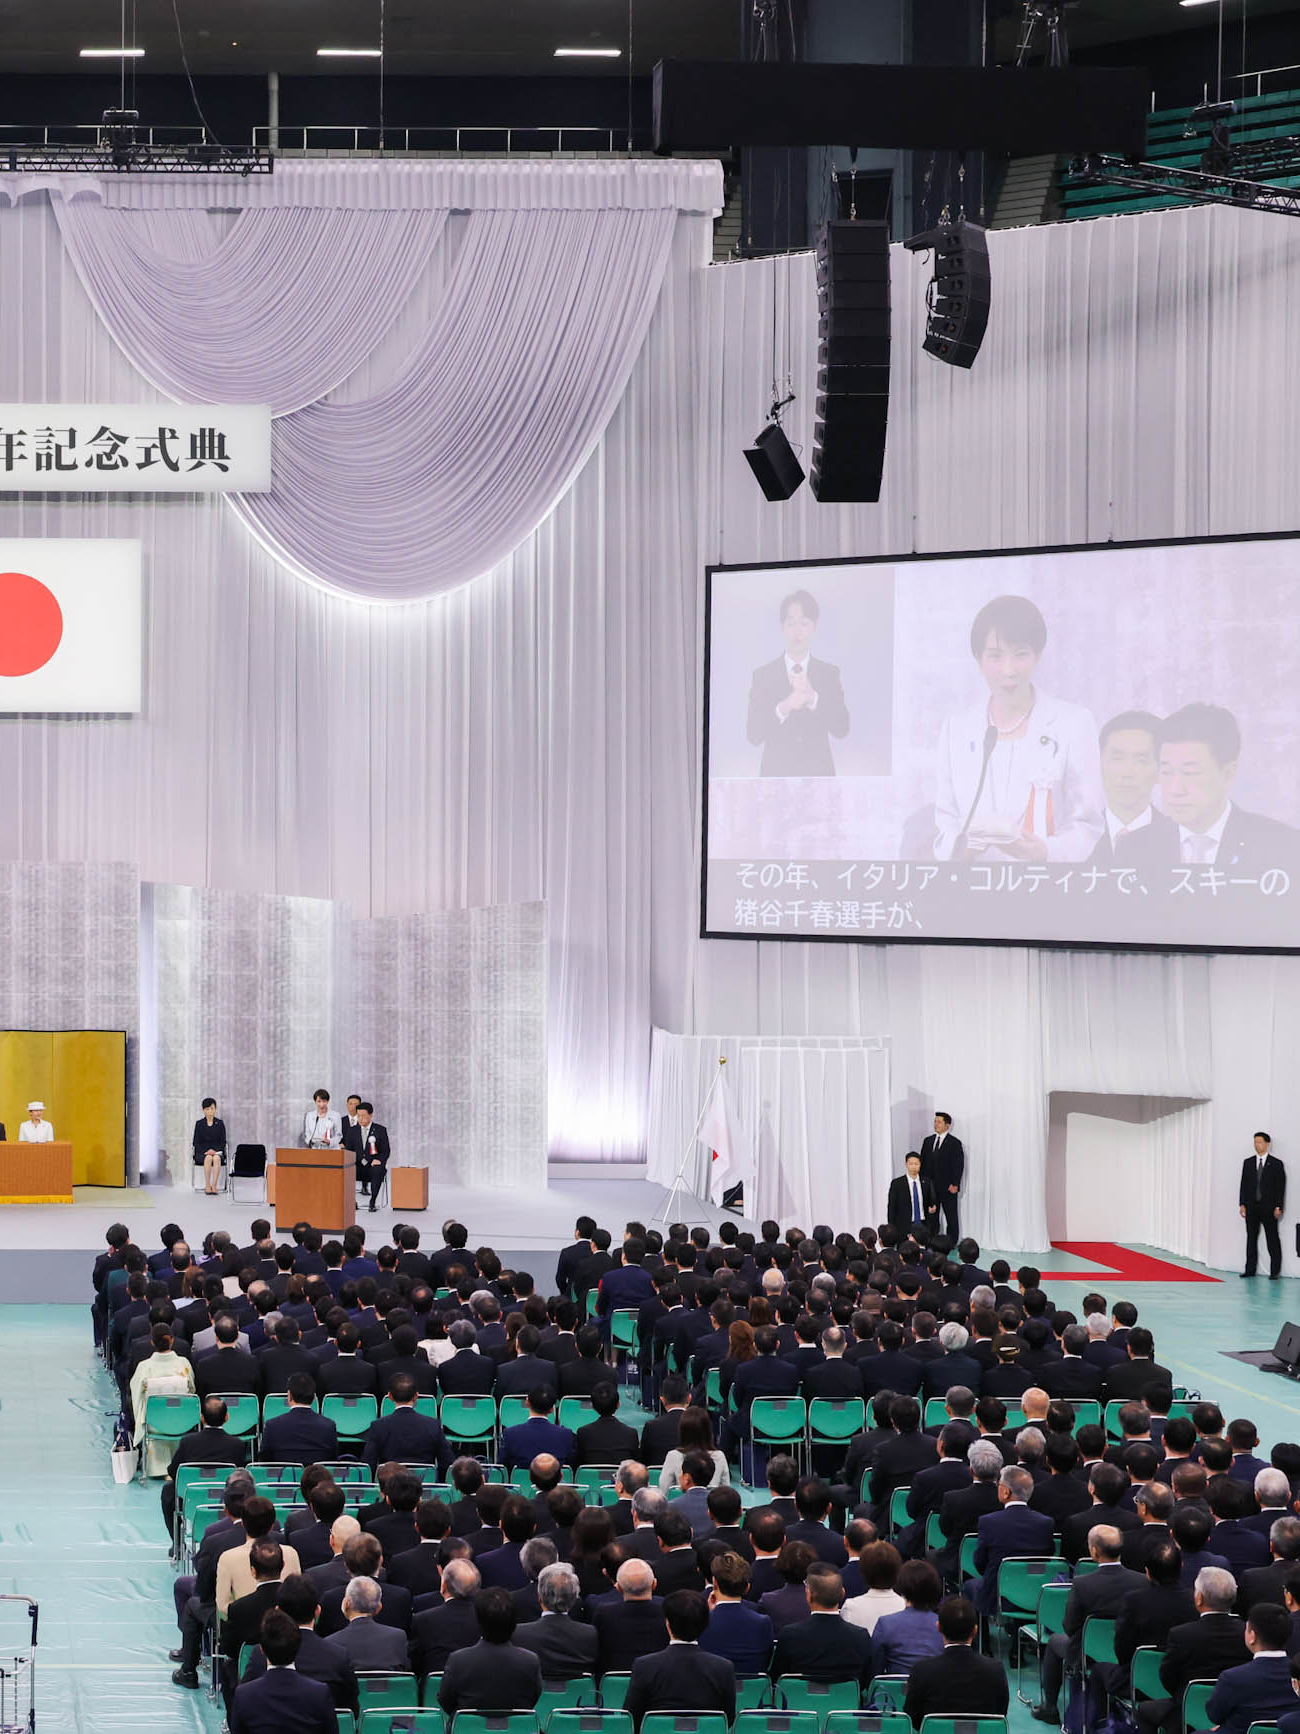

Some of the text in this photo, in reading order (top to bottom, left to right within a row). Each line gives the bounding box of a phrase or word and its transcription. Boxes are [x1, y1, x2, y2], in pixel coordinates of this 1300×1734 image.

[734, 899, 923, 929] 猪谷千春選手が、
